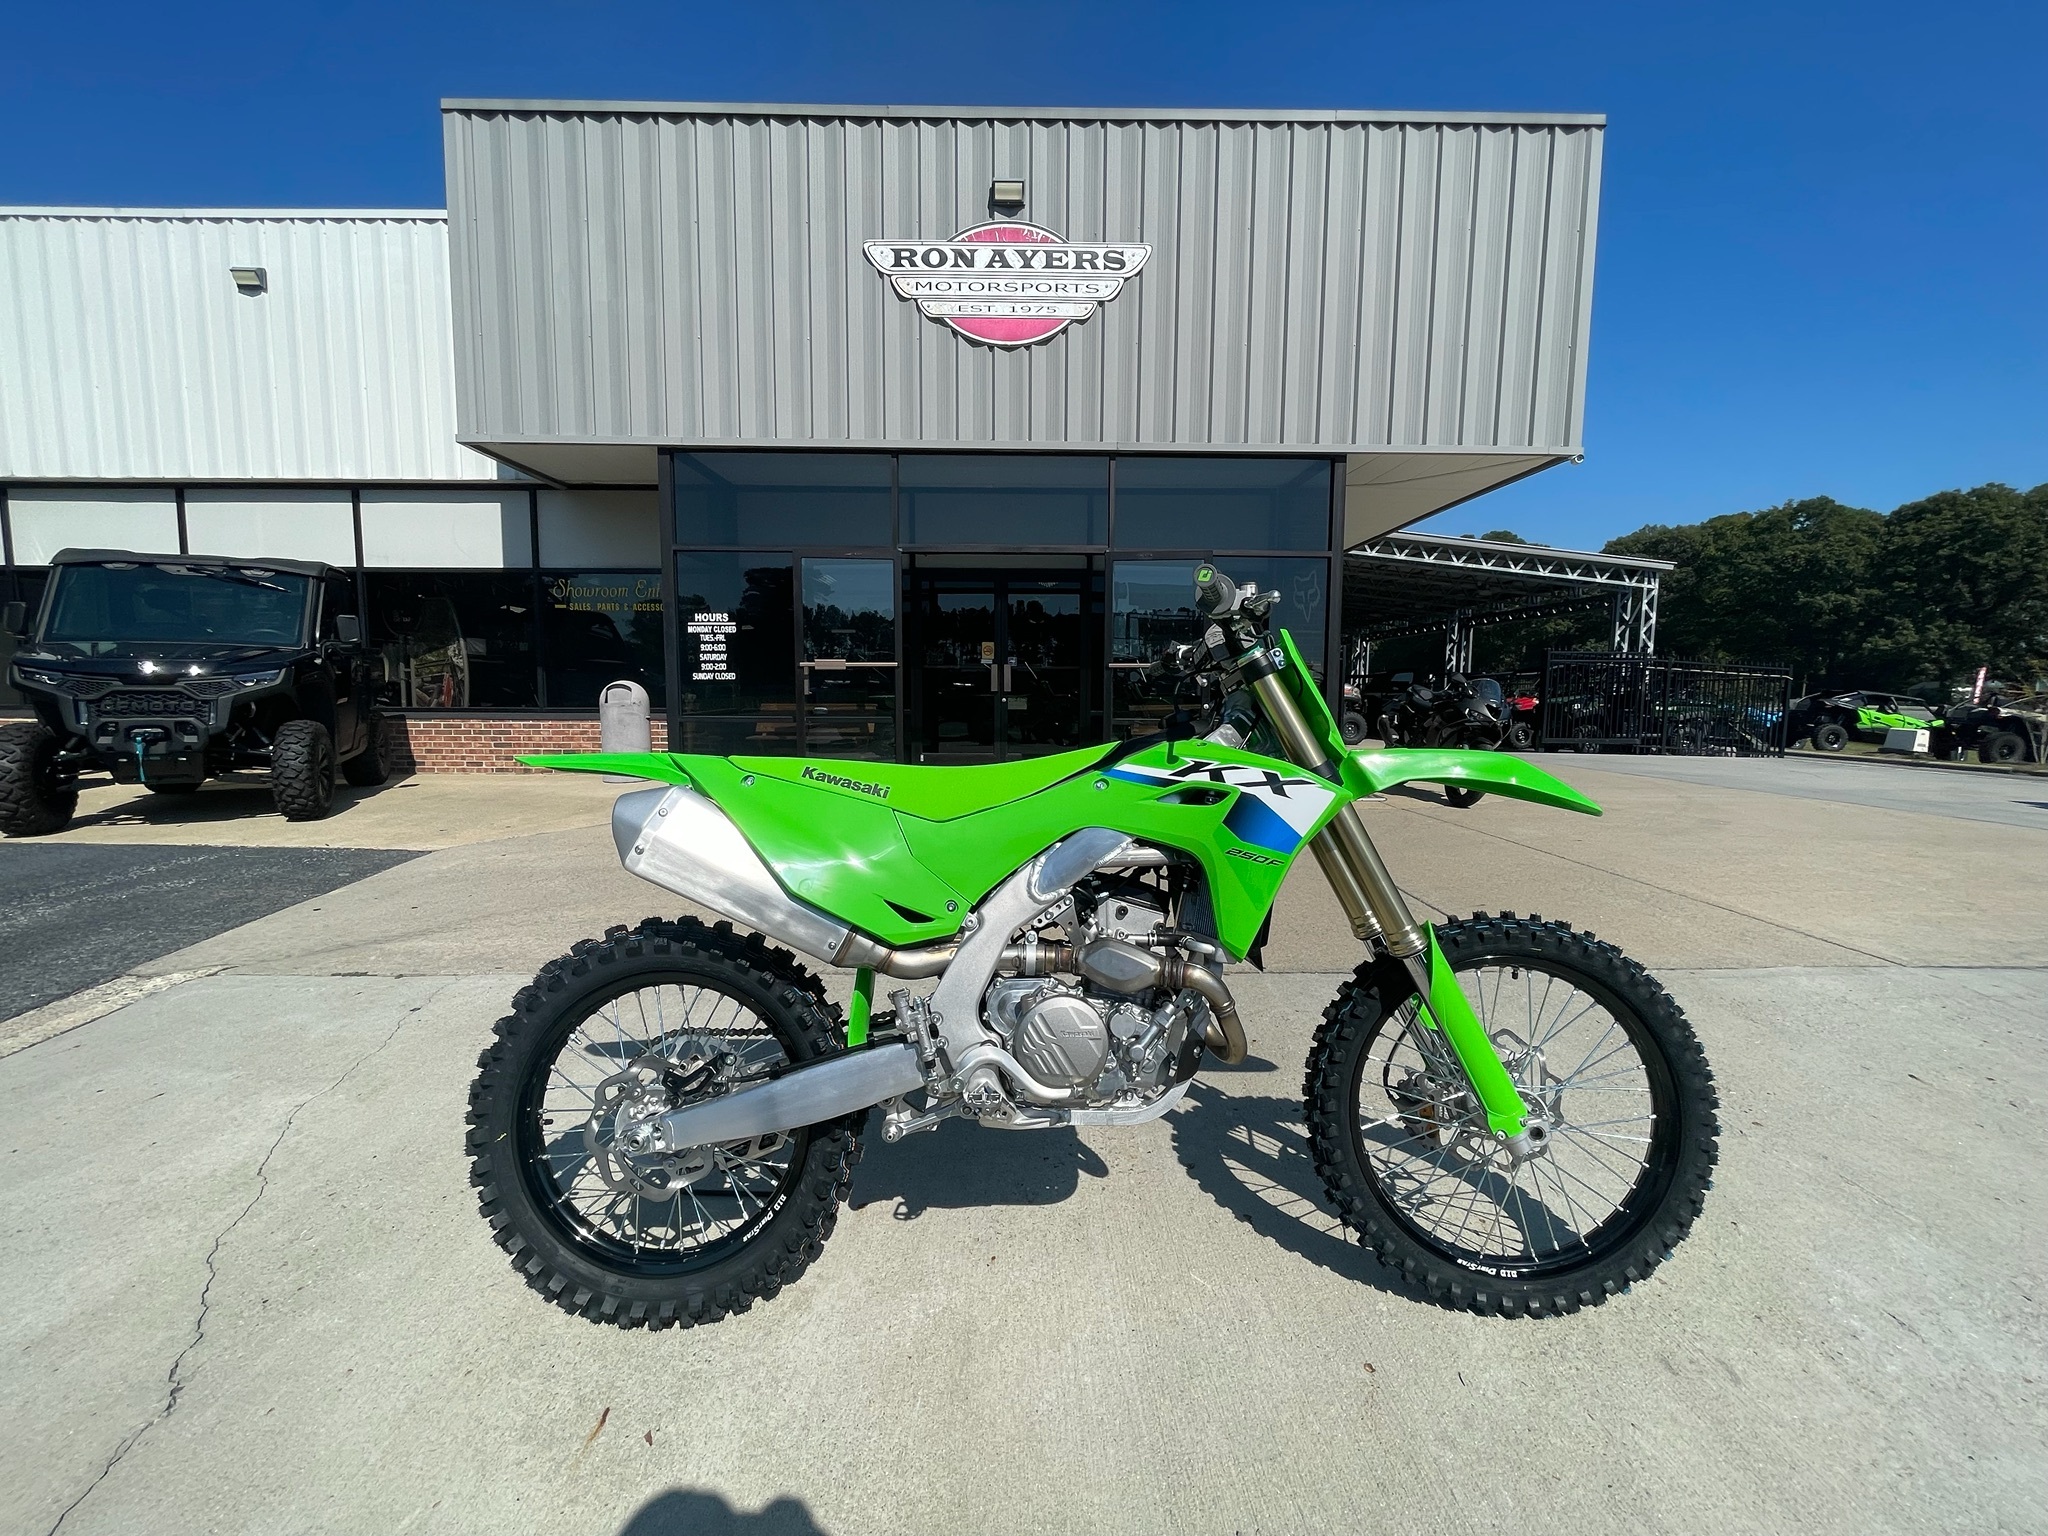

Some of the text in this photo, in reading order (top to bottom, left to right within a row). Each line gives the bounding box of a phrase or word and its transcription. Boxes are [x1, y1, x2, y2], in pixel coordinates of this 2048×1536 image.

[889, 246, 1127, 272] RON AYERS
[914, 280, 1100, 294] MOTORSPORTS
[957, 304, 1057, 314] EST. 1975
[552, 578, 629, 599] Showroom
[569, 602, 594, 612] SALES,
[597, 602, 620, 611] PARTS
[694, 612, 730, 622] HOURS
[687, 625, 737, 633] MONDAY CLOSED
[700, 643, 727, 651] 9:00-6:00
[699, 653, 728, 661] SATURDAY
[692, 672, 736, 680] SUNDAY CLOSED
[801, 766, 891, 799] Kawasaki
[1168, 759, 1318, 800] KX
[1224, 847, 1285, 867] 250F
